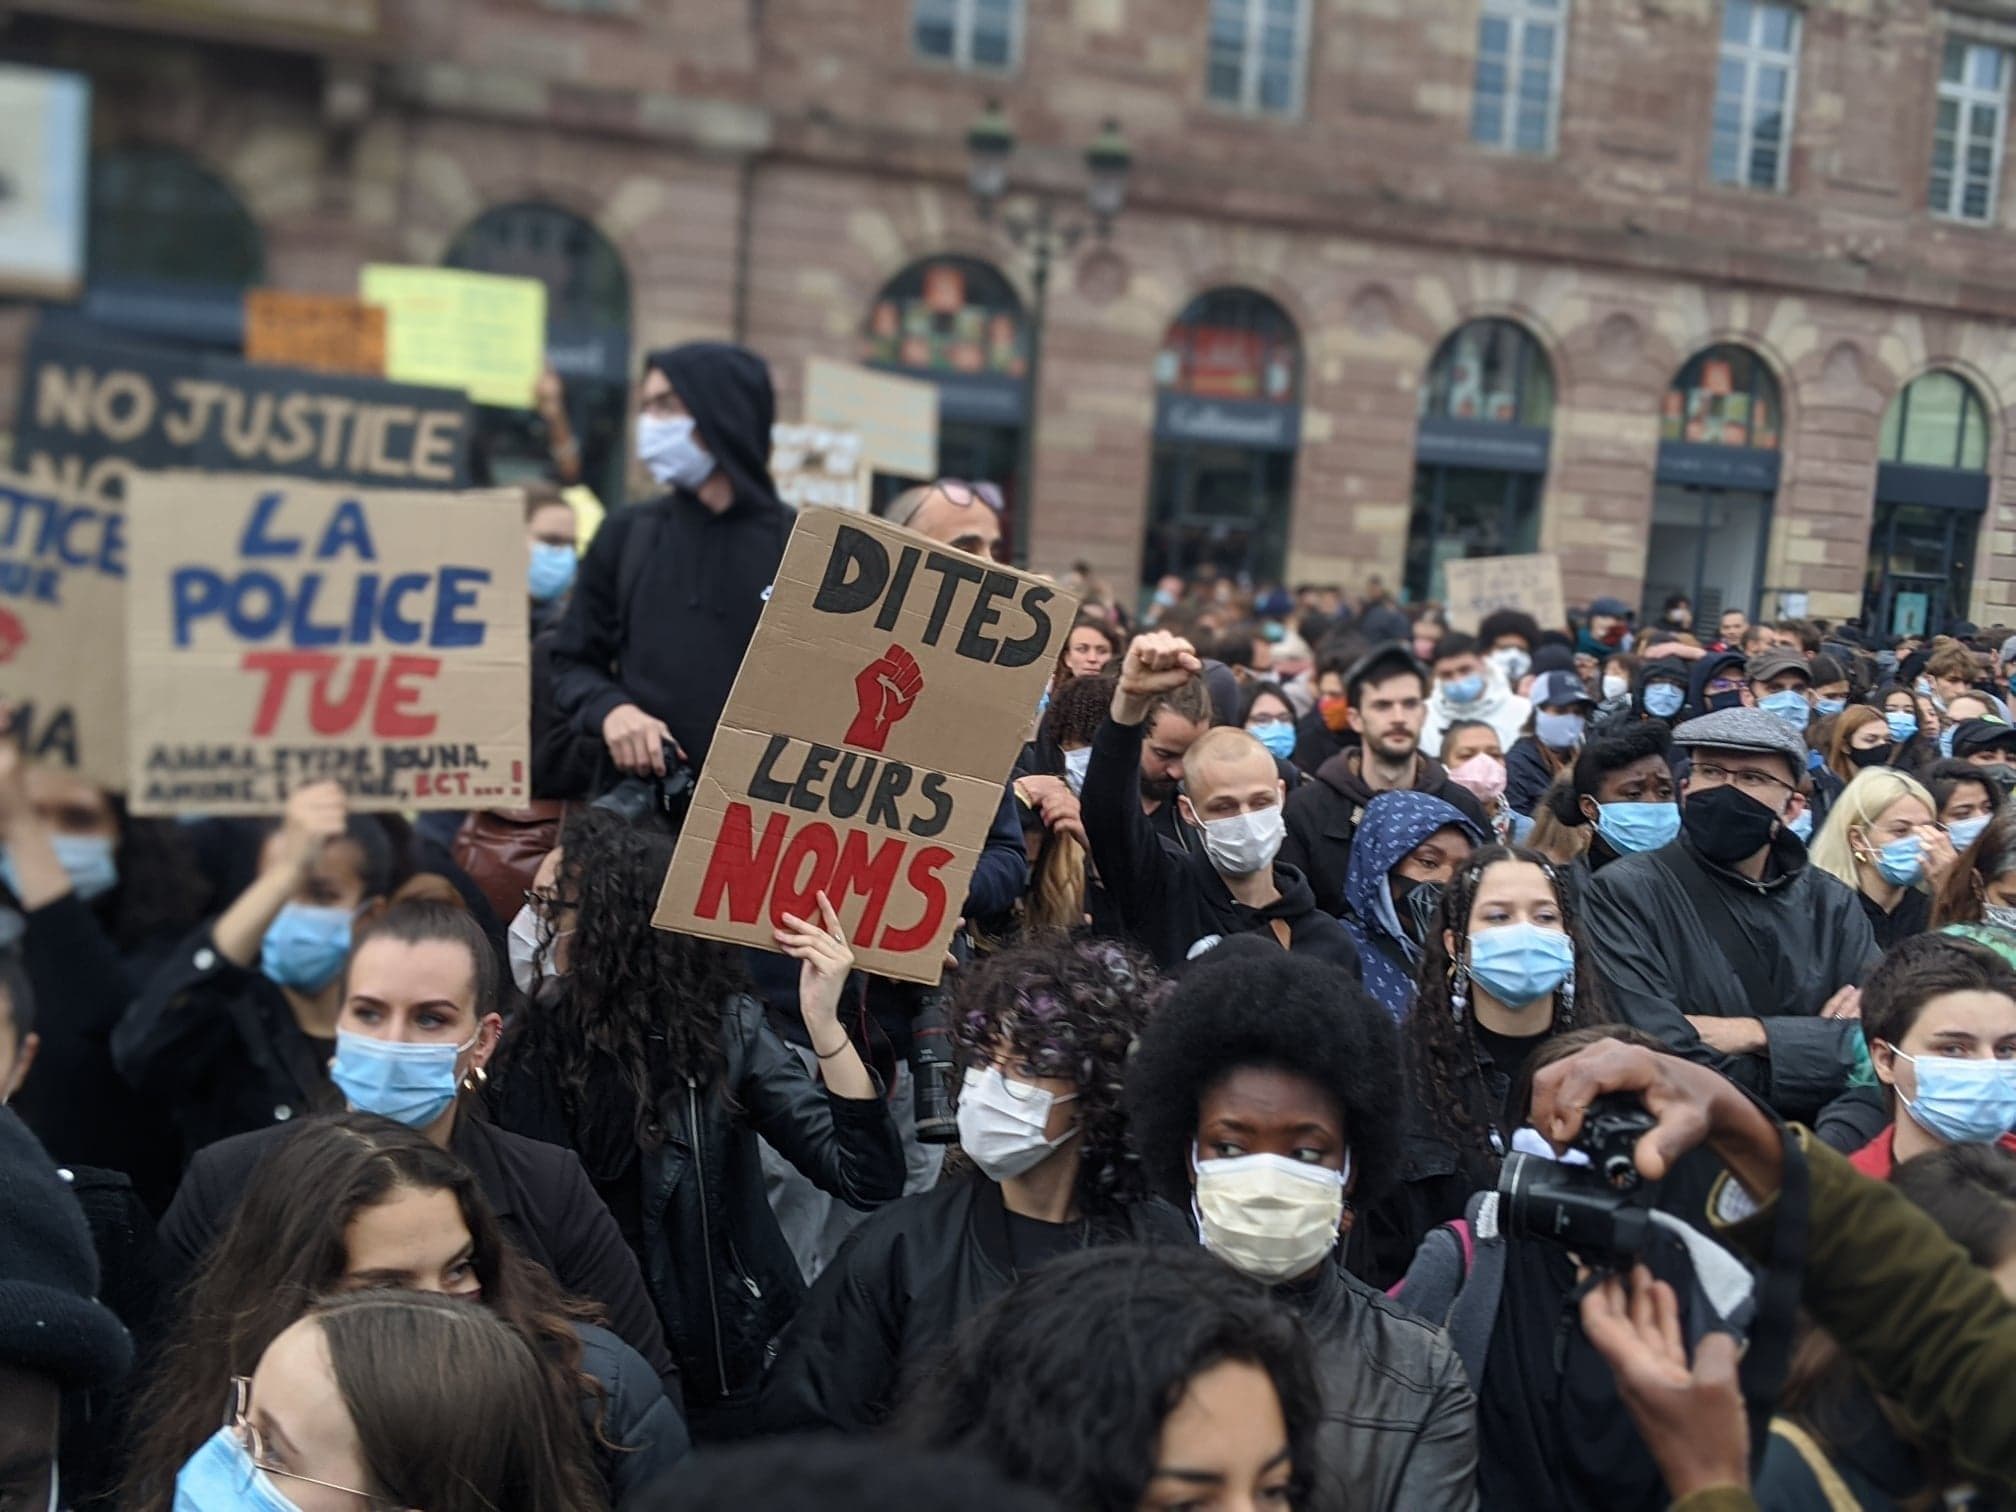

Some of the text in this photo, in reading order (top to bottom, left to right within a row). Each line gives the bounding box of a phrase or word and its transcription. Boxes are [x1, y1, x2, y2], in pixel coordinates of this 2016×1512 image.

[36, 365, 463, 482] NO JUSTICE
[238, 491, 377, 562] LA
[171, 565, 493, 649] POLICE
[813, 525, 1055, 668] DITES
[240, 650, 442, 738] TUE
[747, 734, 954, 838] LEURS
[693, 801, 956, 953] NOMS
